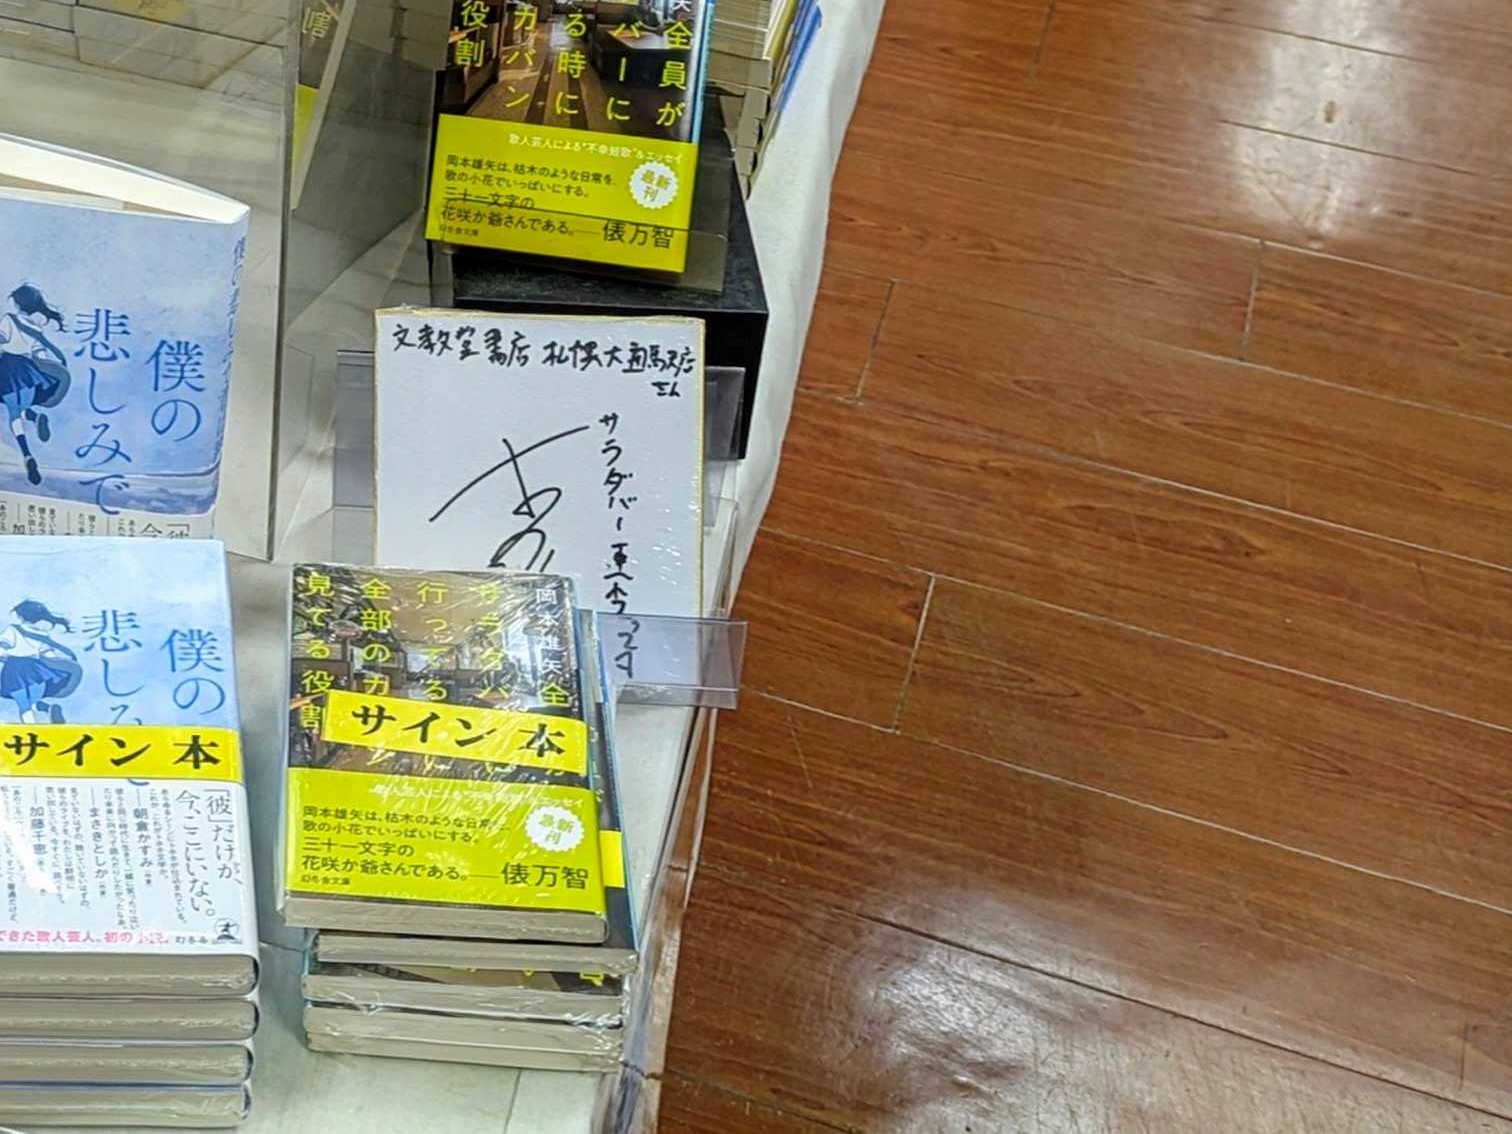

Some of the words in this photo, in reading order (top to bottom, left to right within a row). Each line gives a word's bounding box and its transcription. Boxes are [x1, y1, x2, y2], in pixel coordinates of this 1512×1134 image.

[656, 21, 695, 128] 全員が
[443, 184, 536, 209] 三十一文字の
[601, 218, 675, 250] 俵万智
[72, 307, 134, 517] 悲しみで
[146, 338, 206, 444] 僕の
[534, 586, 564, 676] 岡本雄矢
[160, 627, 226, 716] 僕の
[3, 732, 223, 770] サイン本
[350, 703, 567, 759] サイン本
[132, 807, 155, 869] 朝倉かすみ
[175, 788, 217, 918] 今、ここにいない。
[302, 836, 415, 858] 三十一文字の
[501, 862, 589, 890] 俵万智
